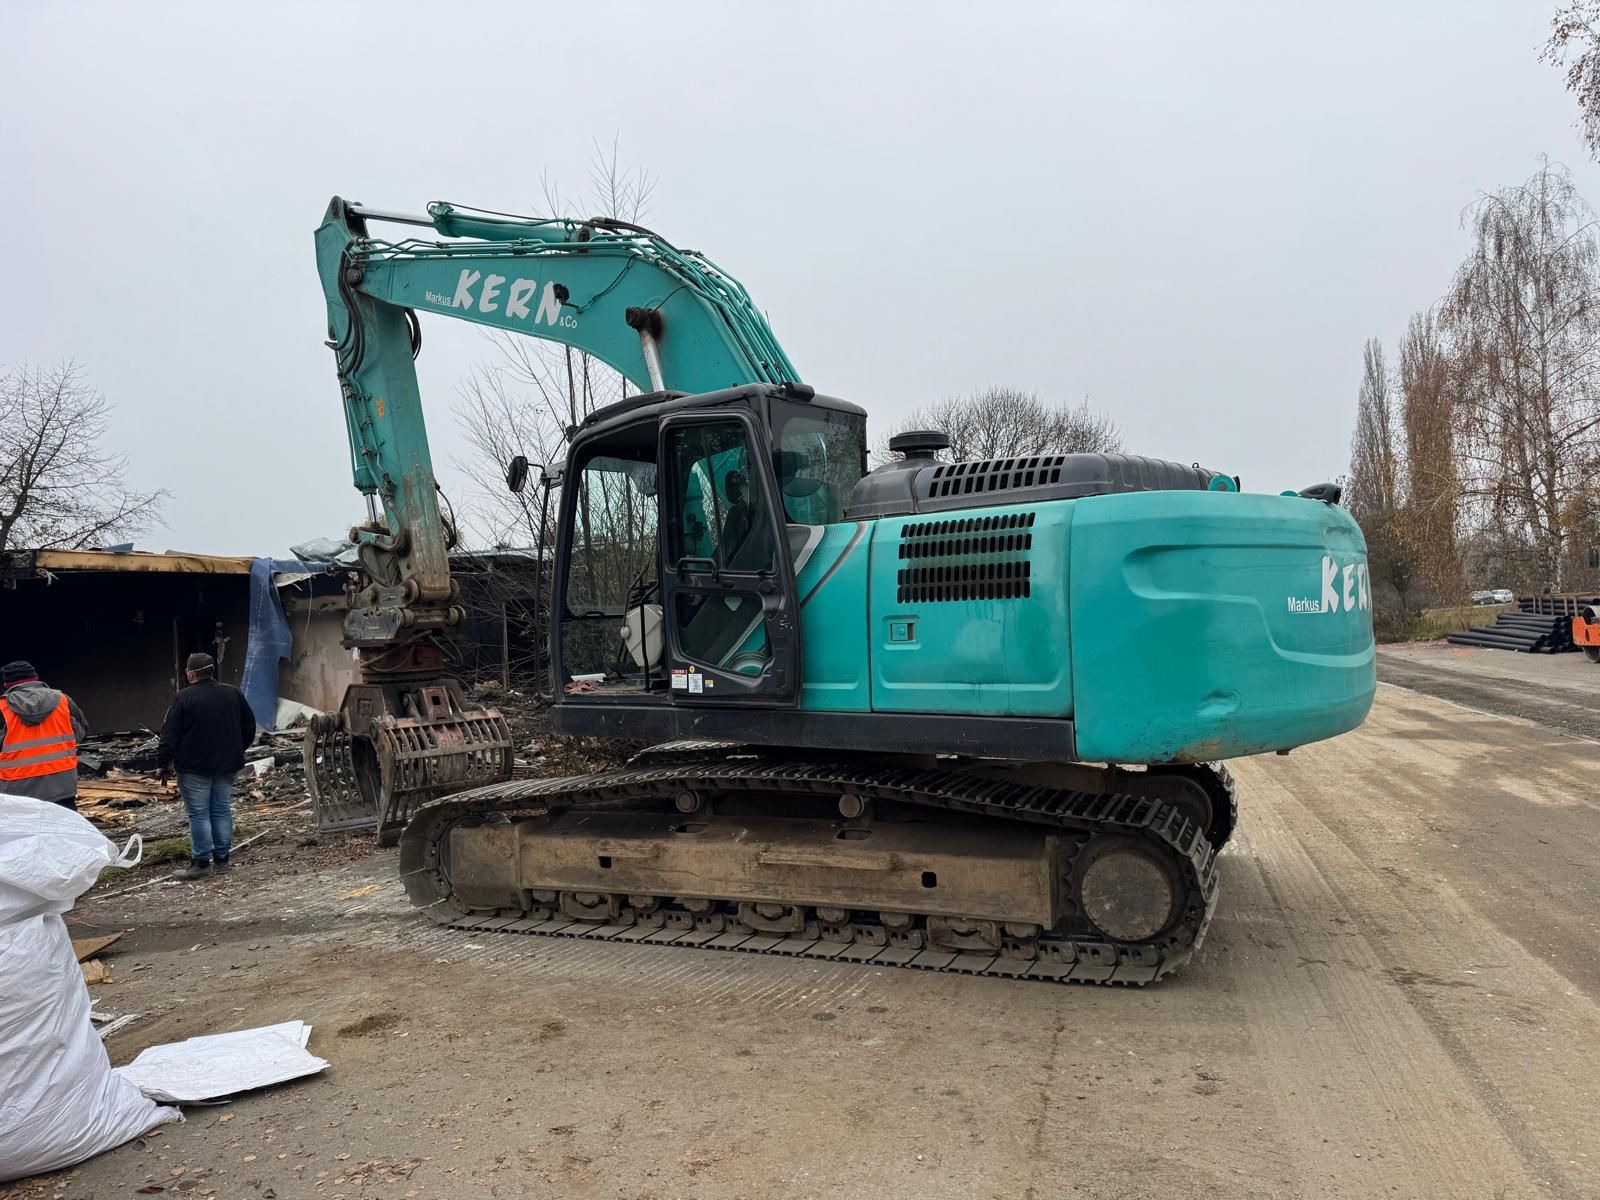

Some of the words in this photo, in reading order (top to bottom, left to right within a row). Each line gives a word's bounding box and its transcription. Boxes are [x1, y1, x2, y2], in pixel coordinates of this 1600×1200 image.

[425, 290, 451, 306] Markus
[452, 269, 562, 326] KERN
[559, 315, 578, 329] &Co
[1287, 596, 1320, 613] Markus
